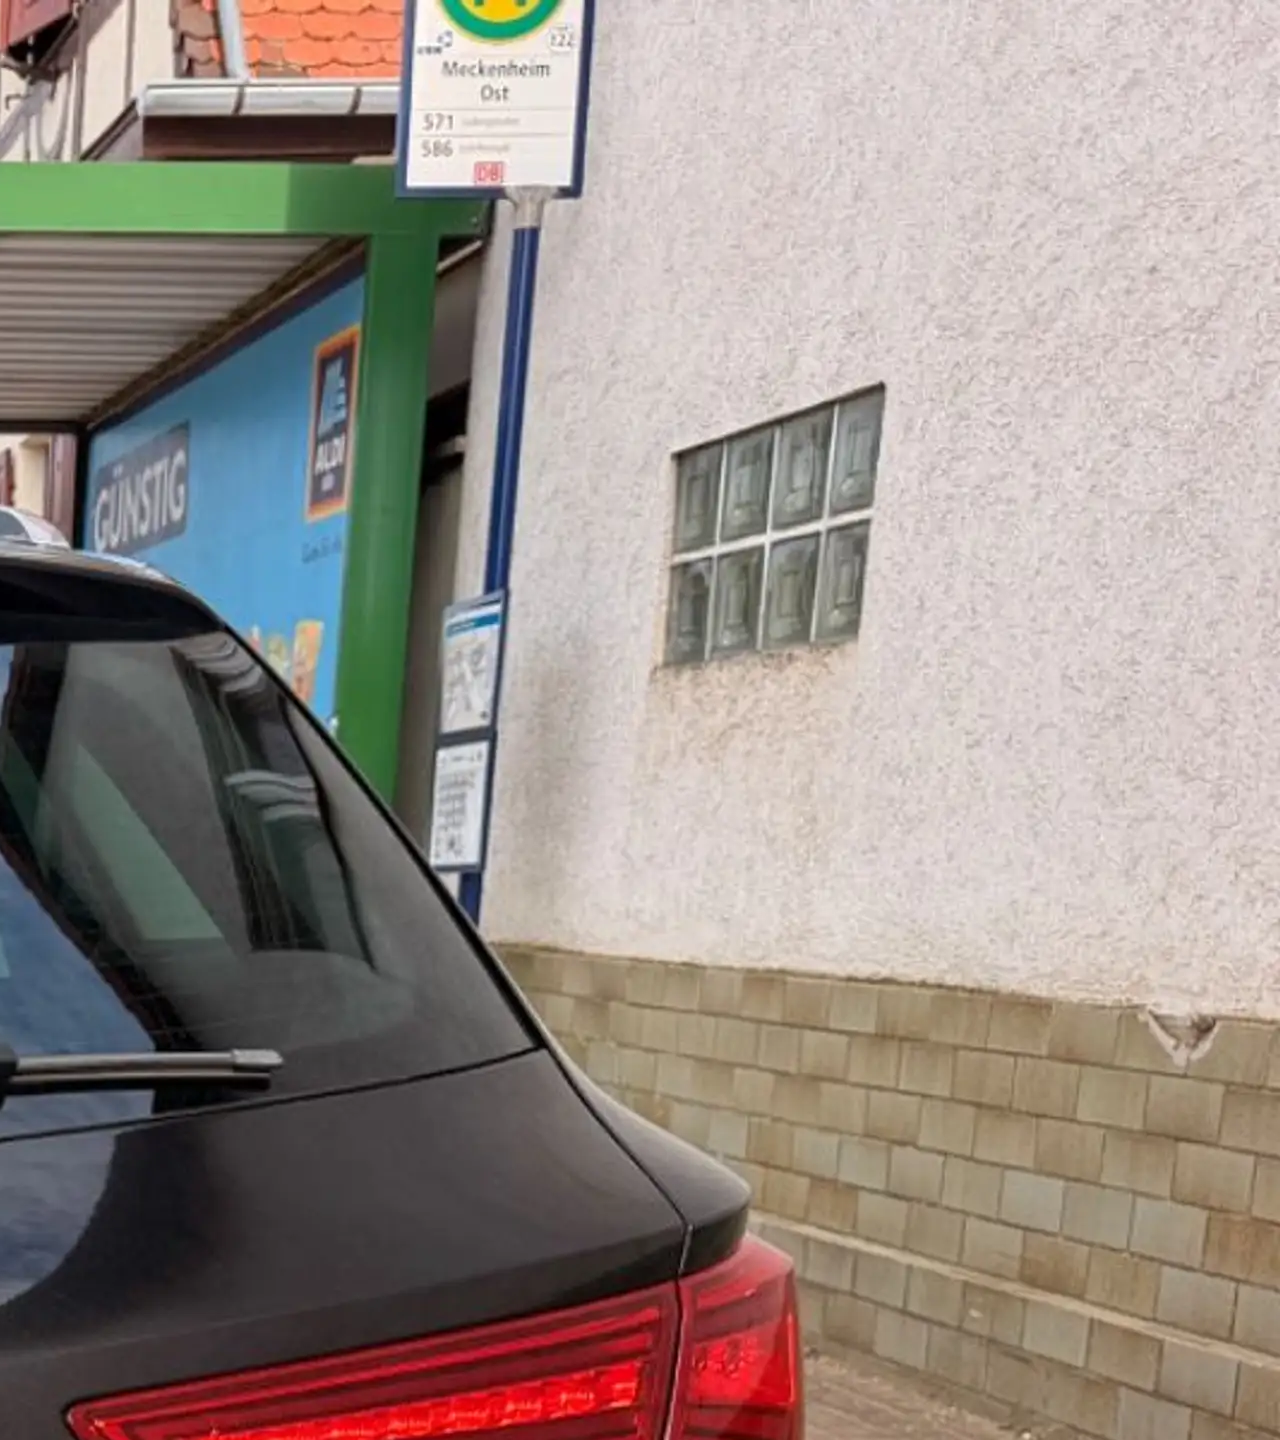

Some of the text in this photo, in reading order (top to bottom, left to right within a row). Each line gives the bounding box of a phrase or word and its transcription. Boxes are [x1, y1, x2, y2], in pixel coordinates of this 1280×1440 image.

[441, 59, 551, 77] Meckenheim
[480, 84, 509, 101] Ost
[94, 449, 186, 552] GÜNSTIG
